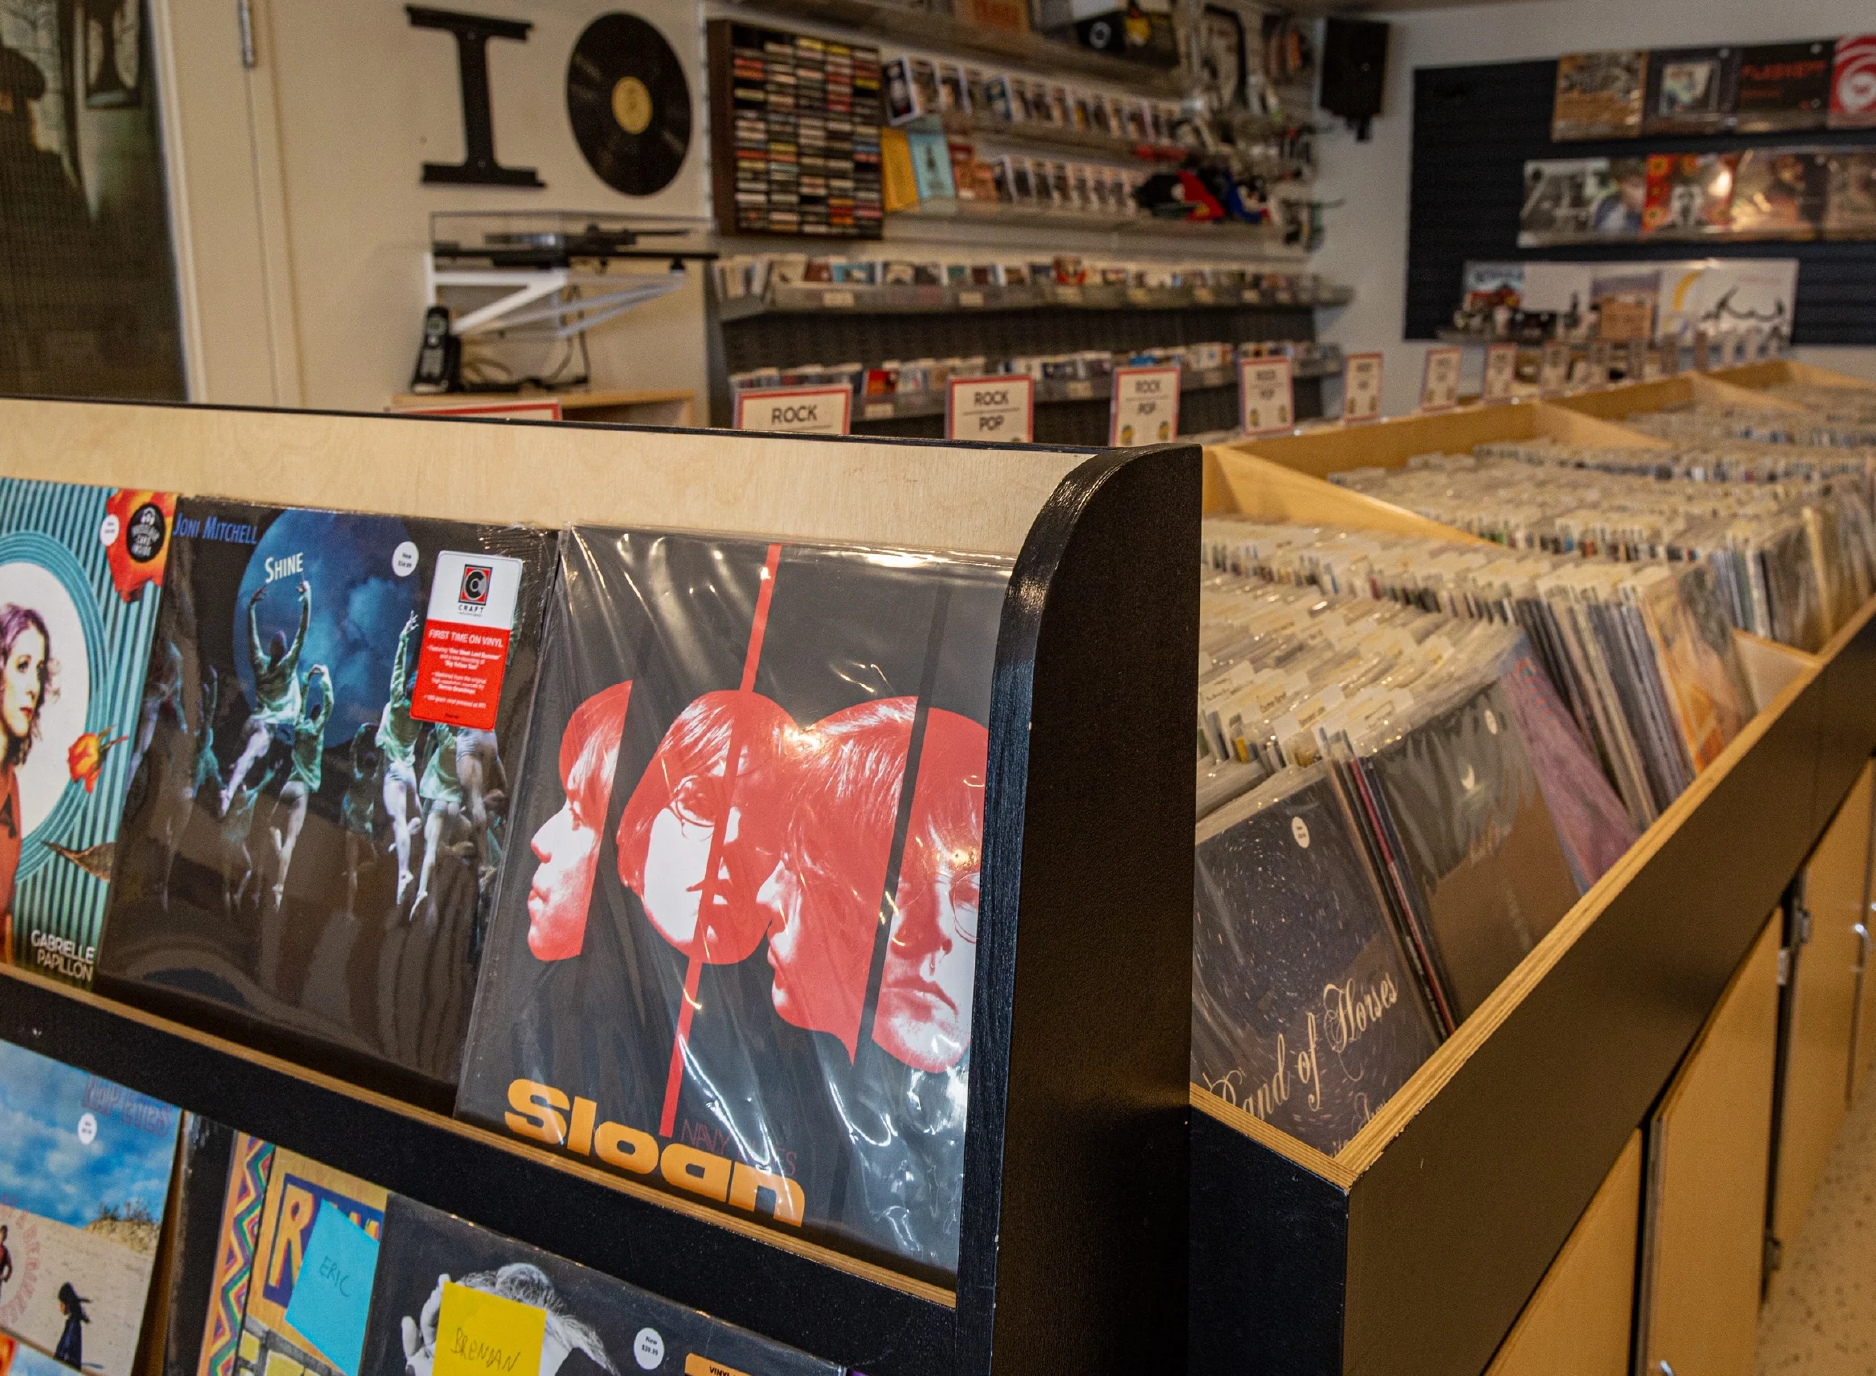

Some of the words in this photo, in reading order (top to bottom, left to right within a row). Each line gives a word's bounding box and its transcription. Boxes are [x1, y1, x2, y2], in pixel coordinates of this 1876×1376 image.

[974, 390, 1009, 406] ROCK
[771, 404, 818, 425] ROCK
[979, 415, 1005, 432] POP
[458, 604, 485, 614] CRAFT
[428, 629, 450, 640] FIRST
[451, 631, 468, 643] TIME
[468, 634, 481, 645] ON
[482, 636, 504, 648] VINYL
[31, 930, 95, 964] GABRIELLE
[37, 949, 94, 982] PAPILLON
[1298, 1012, 1321, 1112] of
[1323, 971, 1397, 1060] Horses
[504, 1078, 805, 1228] Sloan
[319, 1255, 351, 1298] ERIC
[645, 1336, 658, 1346] New
